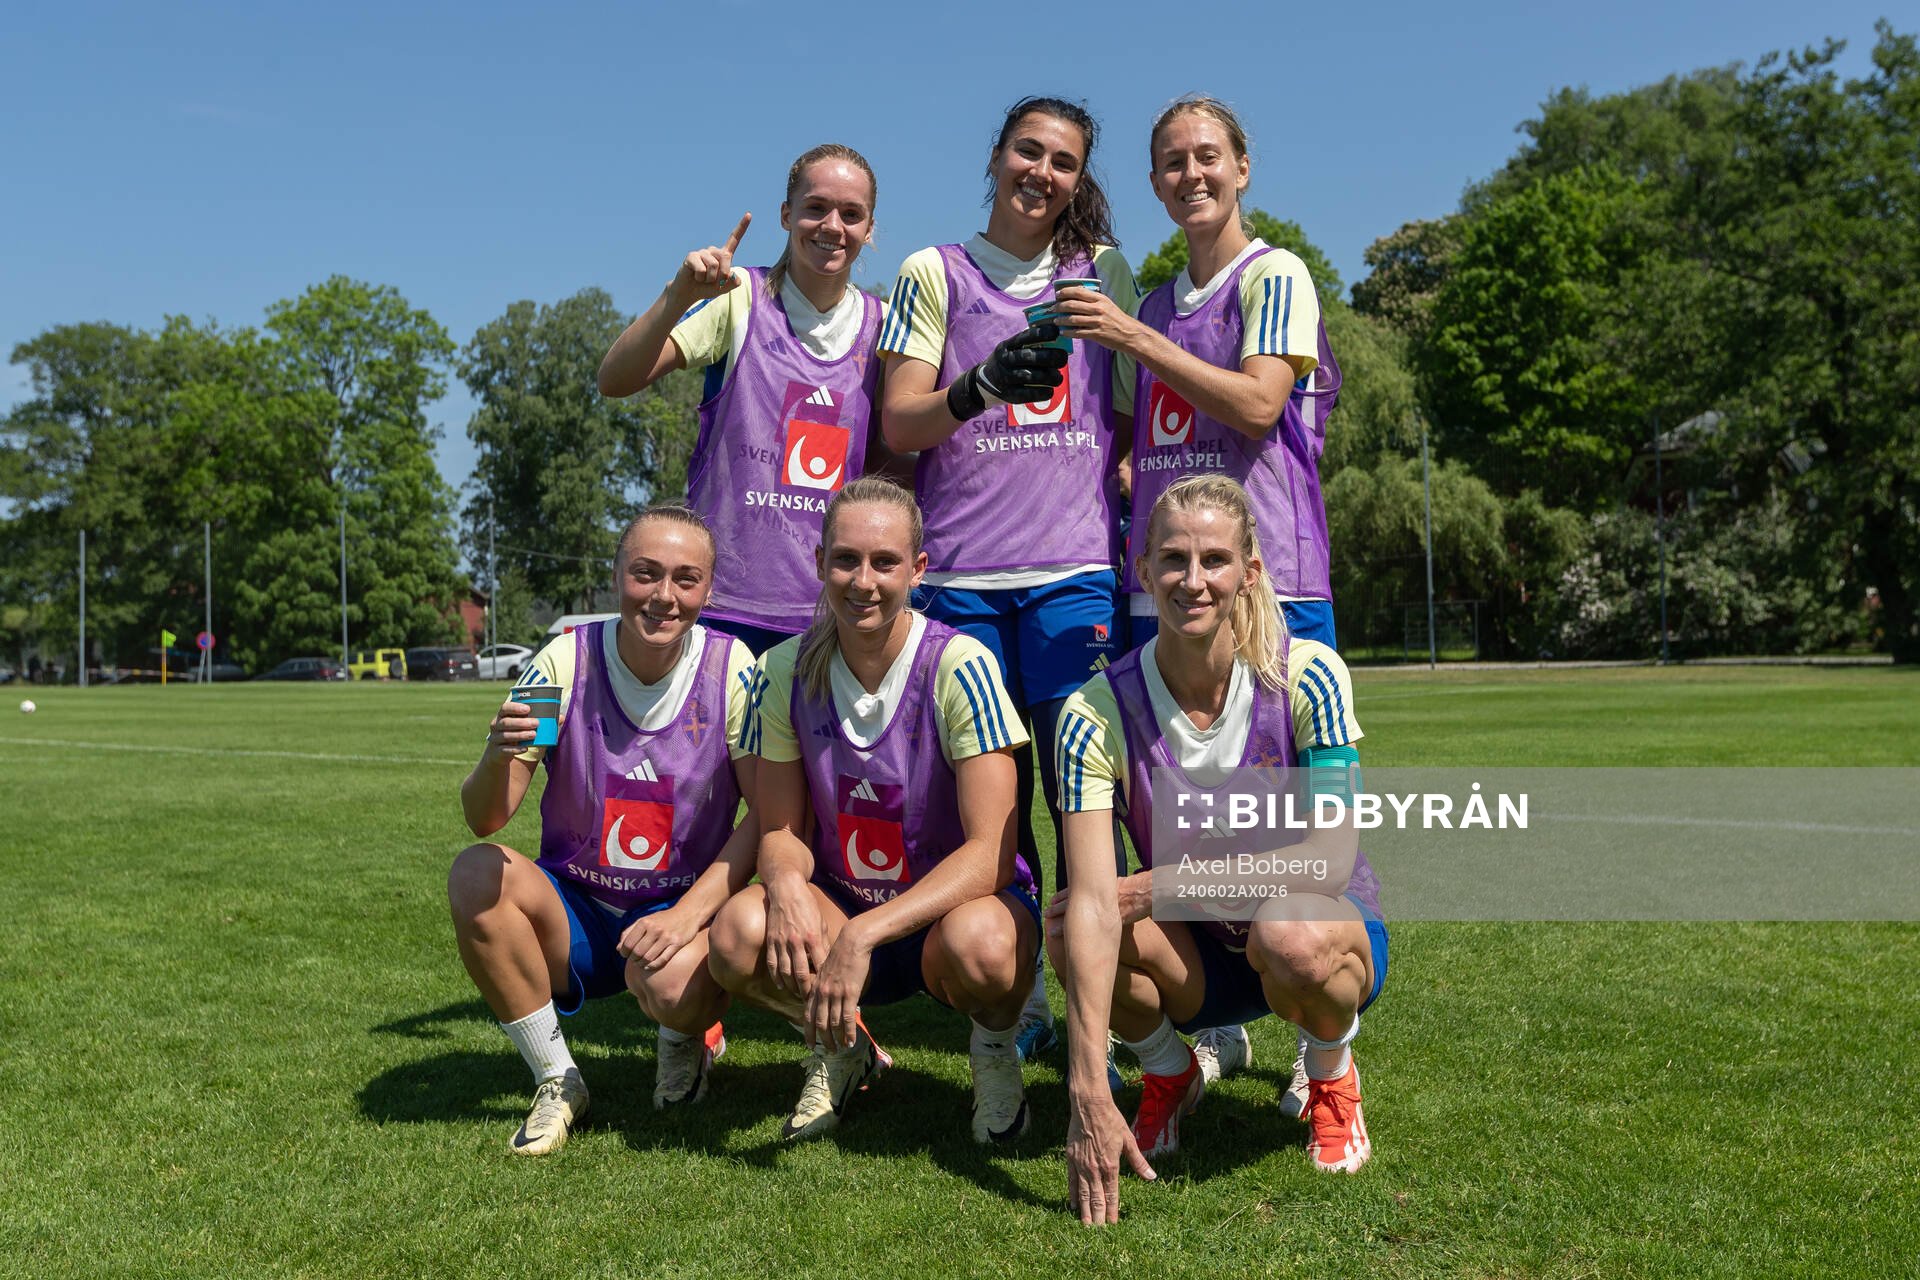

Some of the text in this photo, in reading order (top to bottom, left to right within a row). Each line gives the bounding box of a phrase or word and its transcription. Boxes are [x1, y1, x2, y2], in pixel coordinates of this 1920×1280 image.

[976, 432, 1100, 453] SVENSKA SPEL
[1138, 453, 1225, 472] ENSKA SPEL
[745, 491, 827, 513] SVENSKA
[567, 862, 651, 891] SVENSKA
